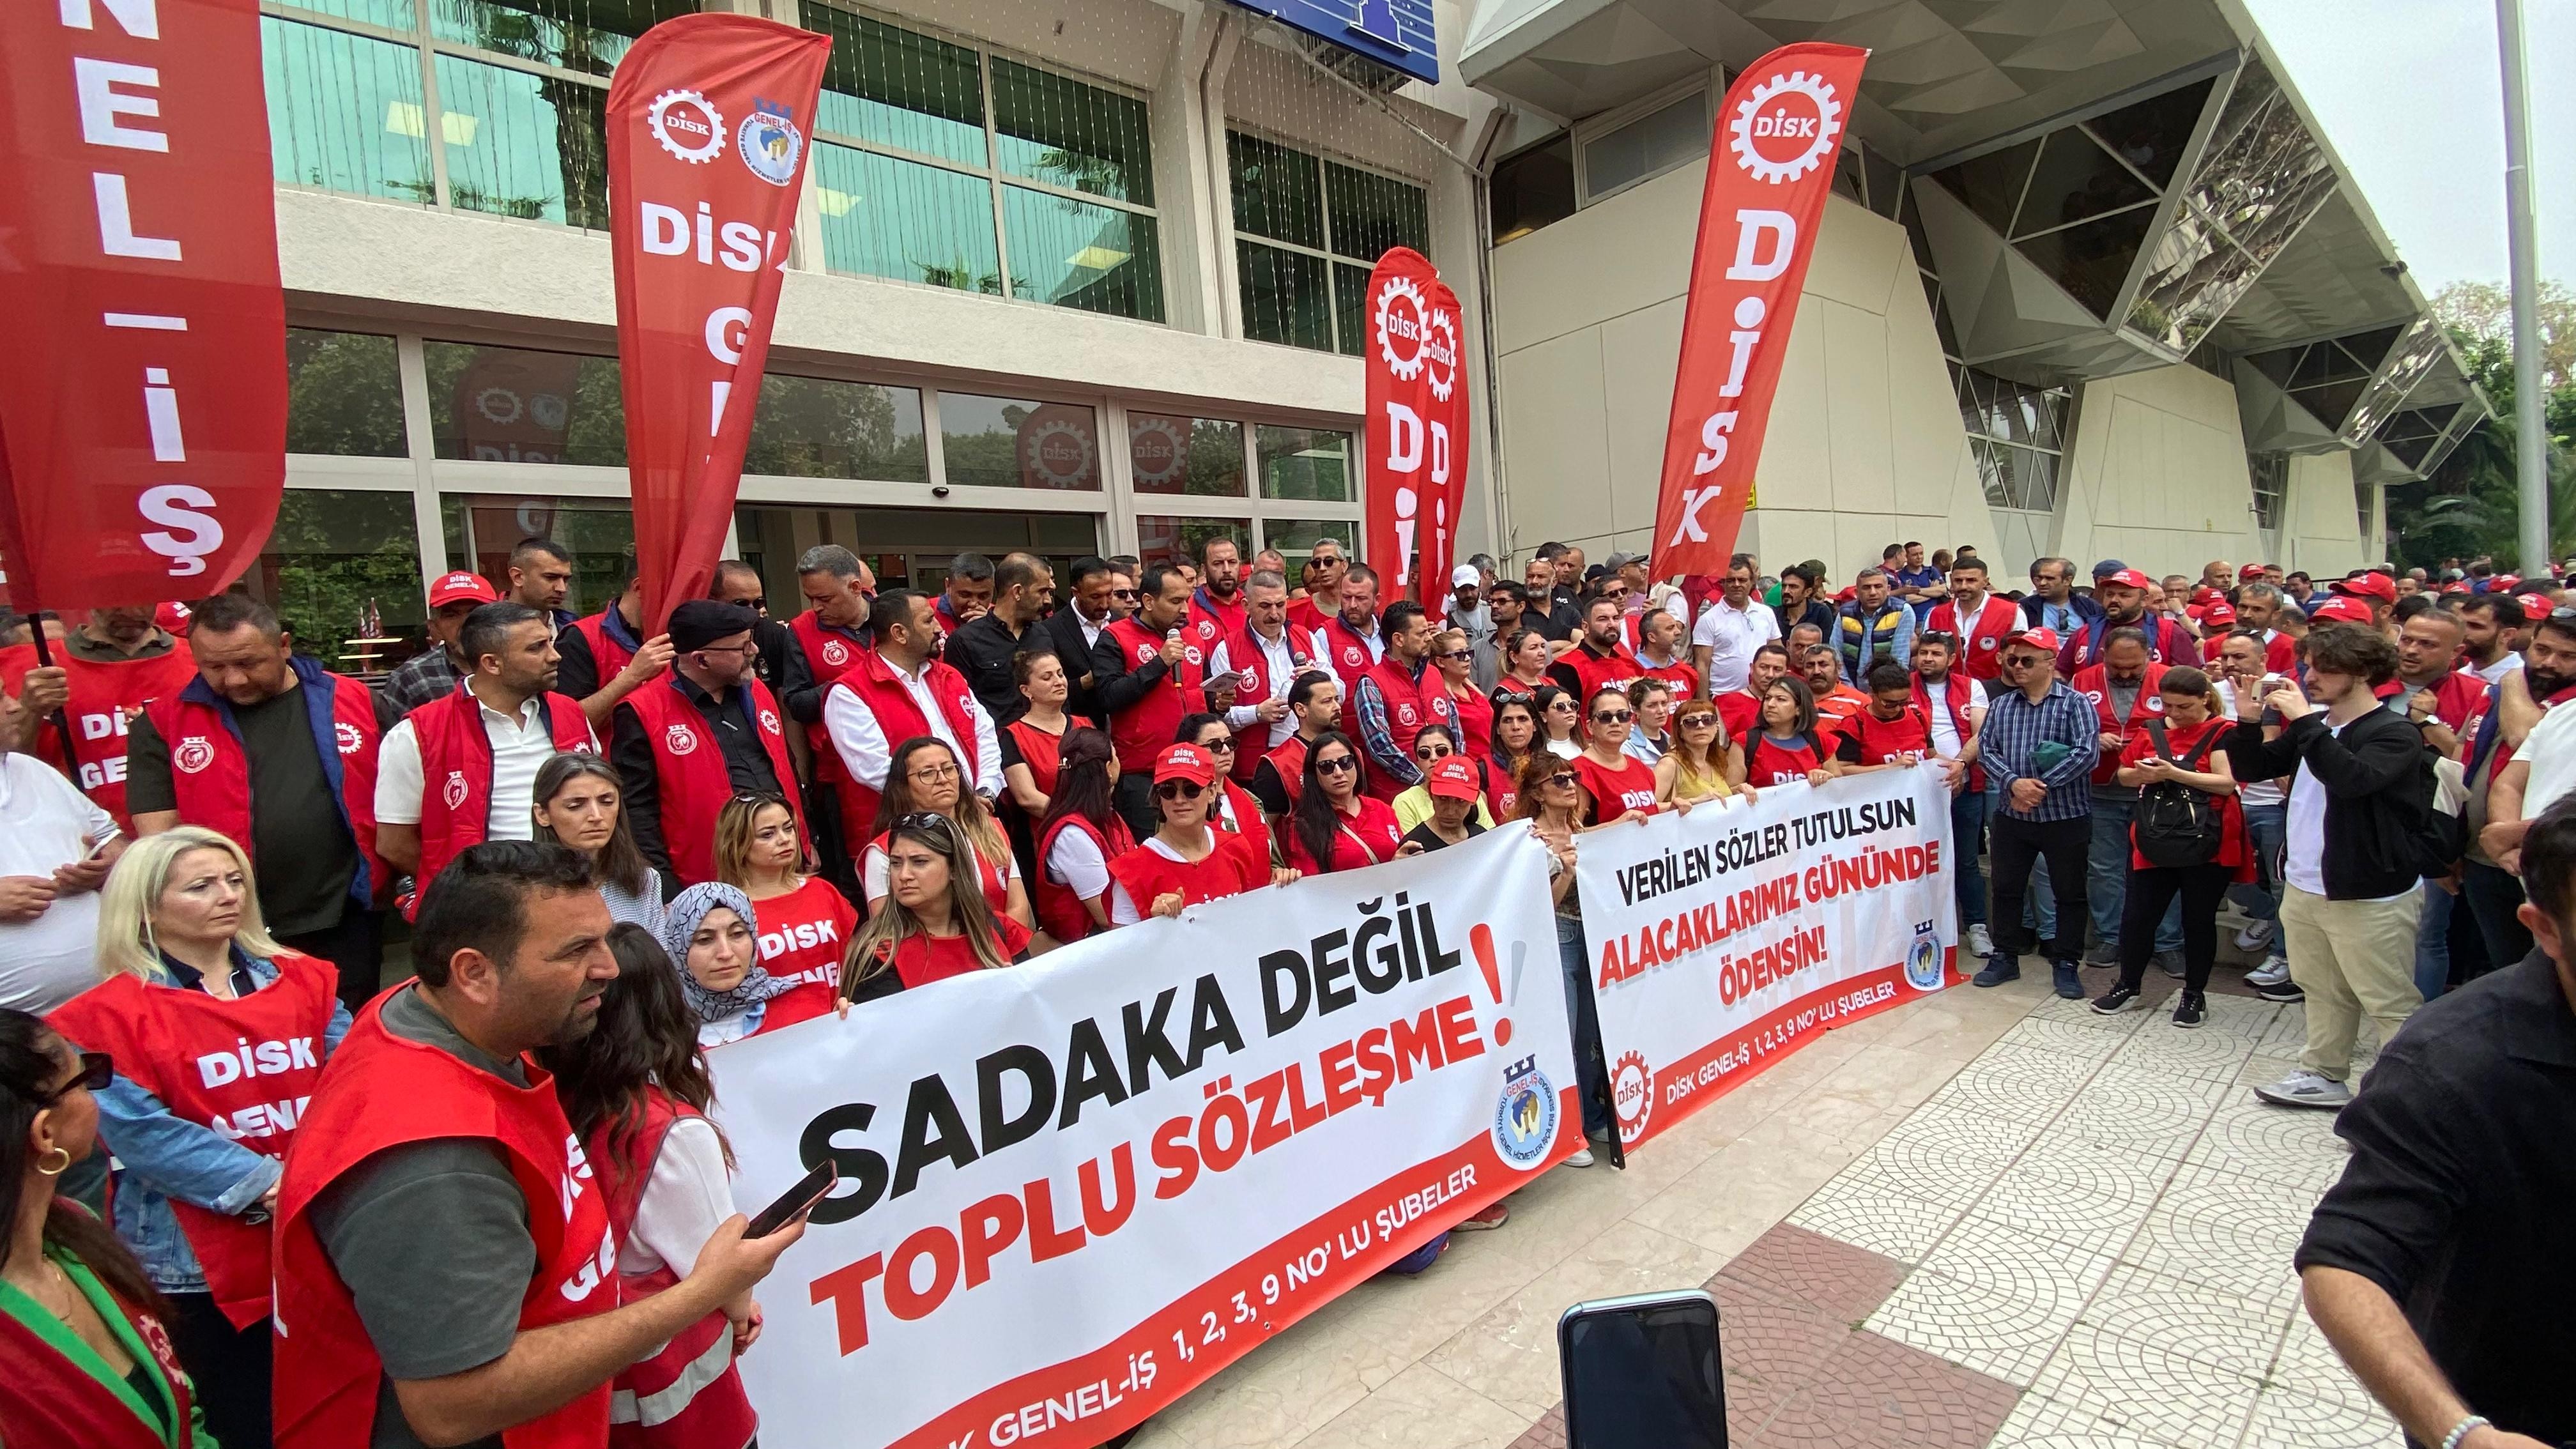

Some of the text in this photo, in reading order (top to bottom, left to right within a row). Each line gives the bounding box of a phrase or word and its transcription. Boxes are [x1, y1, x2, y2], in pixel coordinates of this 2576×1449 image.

[666, 111, 710, 137] DİSK
[1754, 107, 1817, 139] DİSK
[1388, 309, 1420, 342] DİSK
[1430, 337, 1451, 367] DİSK
[1668, 208, 1797, 548] DİSK
[1386, 401, 1425, 586] Dİ
[449, 574, 472, 583] DİSK
[1174, 747, 1195, 758] DİSK
[1447, 763, 1465, 773] DİSK
[1616, 797, 1916, 907] VERİLEN SÖZLER TUTULSUN
[758, 919, 838, 961] DİSK
[1598, 872, 1801, 990] ALACAKLARIMIZ
[1804, 839, 1940, 904] GÜNÜNDE
[1719, 924, 1828, 1007] ÖDENSİN!
[197, 1037, 318, 1089] DİSK
[799, 973, 1245, 1225] SADAKA
[1258, 891, 1461, 1038] DEĞİL
[1666, 1071, 1696, 1105] DİSK
[1698, 1041, 1751, 1086] GENEL-İŞ
[1754, 1036, 1765, 1057] 1,
[1764, 1031, 1777, 1050] 2,
[1775, 1024, 1788, 1044] 3,
[1786, 1018, 1795, 1038] 9
[1820, 1000, 1836, 1022] LU
[1837, 981, 1897, 1017] ŞUBELER
[1618, 1080, 1643, 1107] DİSK
[809, 1140, 1138, 1358] TOPLU
[1150, 994, 1485, 1200] SÖZLEŞME
[988, 1350, 1157, 1448] GENEL-İŞ
[1172, 1328, 1195, 1363] 1,
[1200, 1311, 1227, 1342] 2,
[1231, 1289, 1257, 1324] 3,
[1261, 1273, 1280, 1305] 9
[1338, 1219, 1371, 1261] LU
[1376, 1163, 1478, 1242] ŞUBELER
